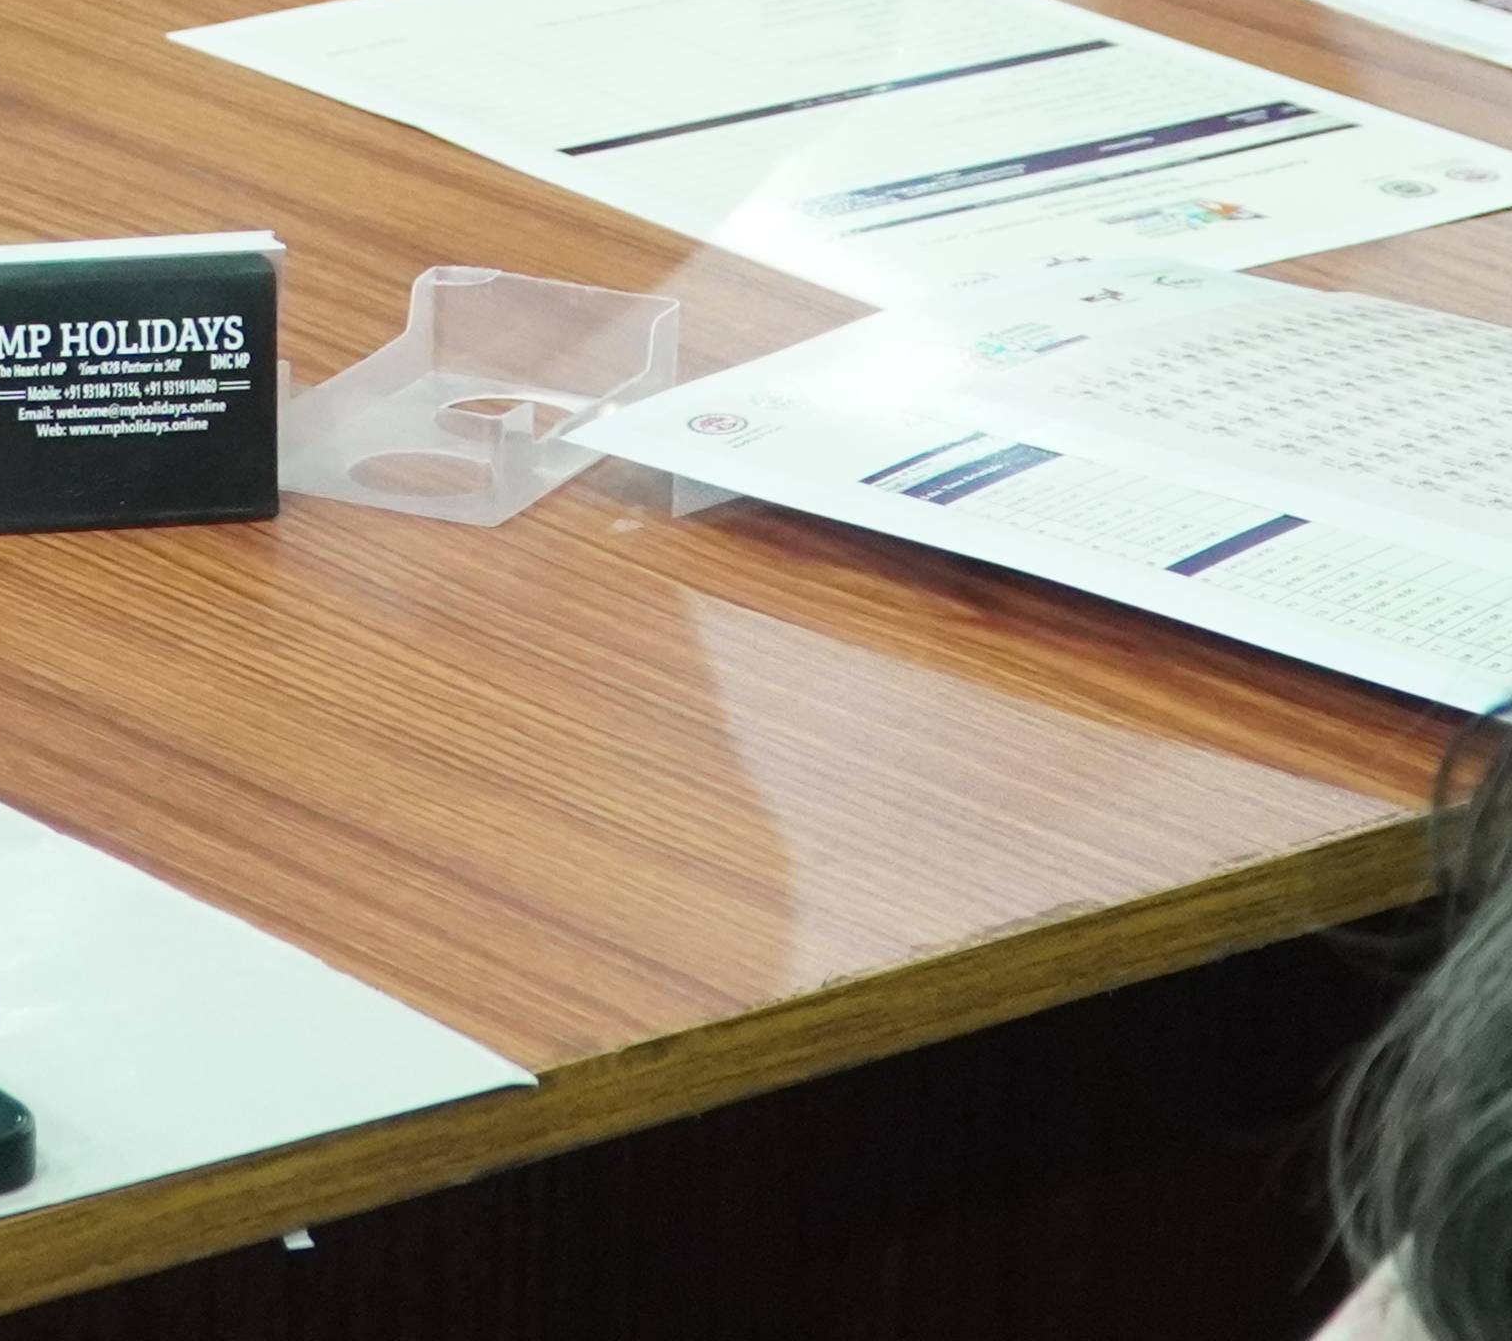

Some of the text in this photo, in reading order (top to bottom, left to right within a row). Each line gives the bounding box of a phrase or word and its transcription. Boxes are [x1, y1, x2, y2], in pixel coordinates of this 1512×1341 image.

[59, 315, 244, 358] HOLIDAYS
[13, 364, 39, 377] Heart
[40, 362, 51, 376] of
[210, 352, 251, 370] DMC MP
[63, 384, 81, 400] +91
[144, 380, 162, 397] +91
[18, 399, 227, 421] Email: welcome@mpholidays.online
[36, 418, 209, 438] Web: www.mpholidays.online
